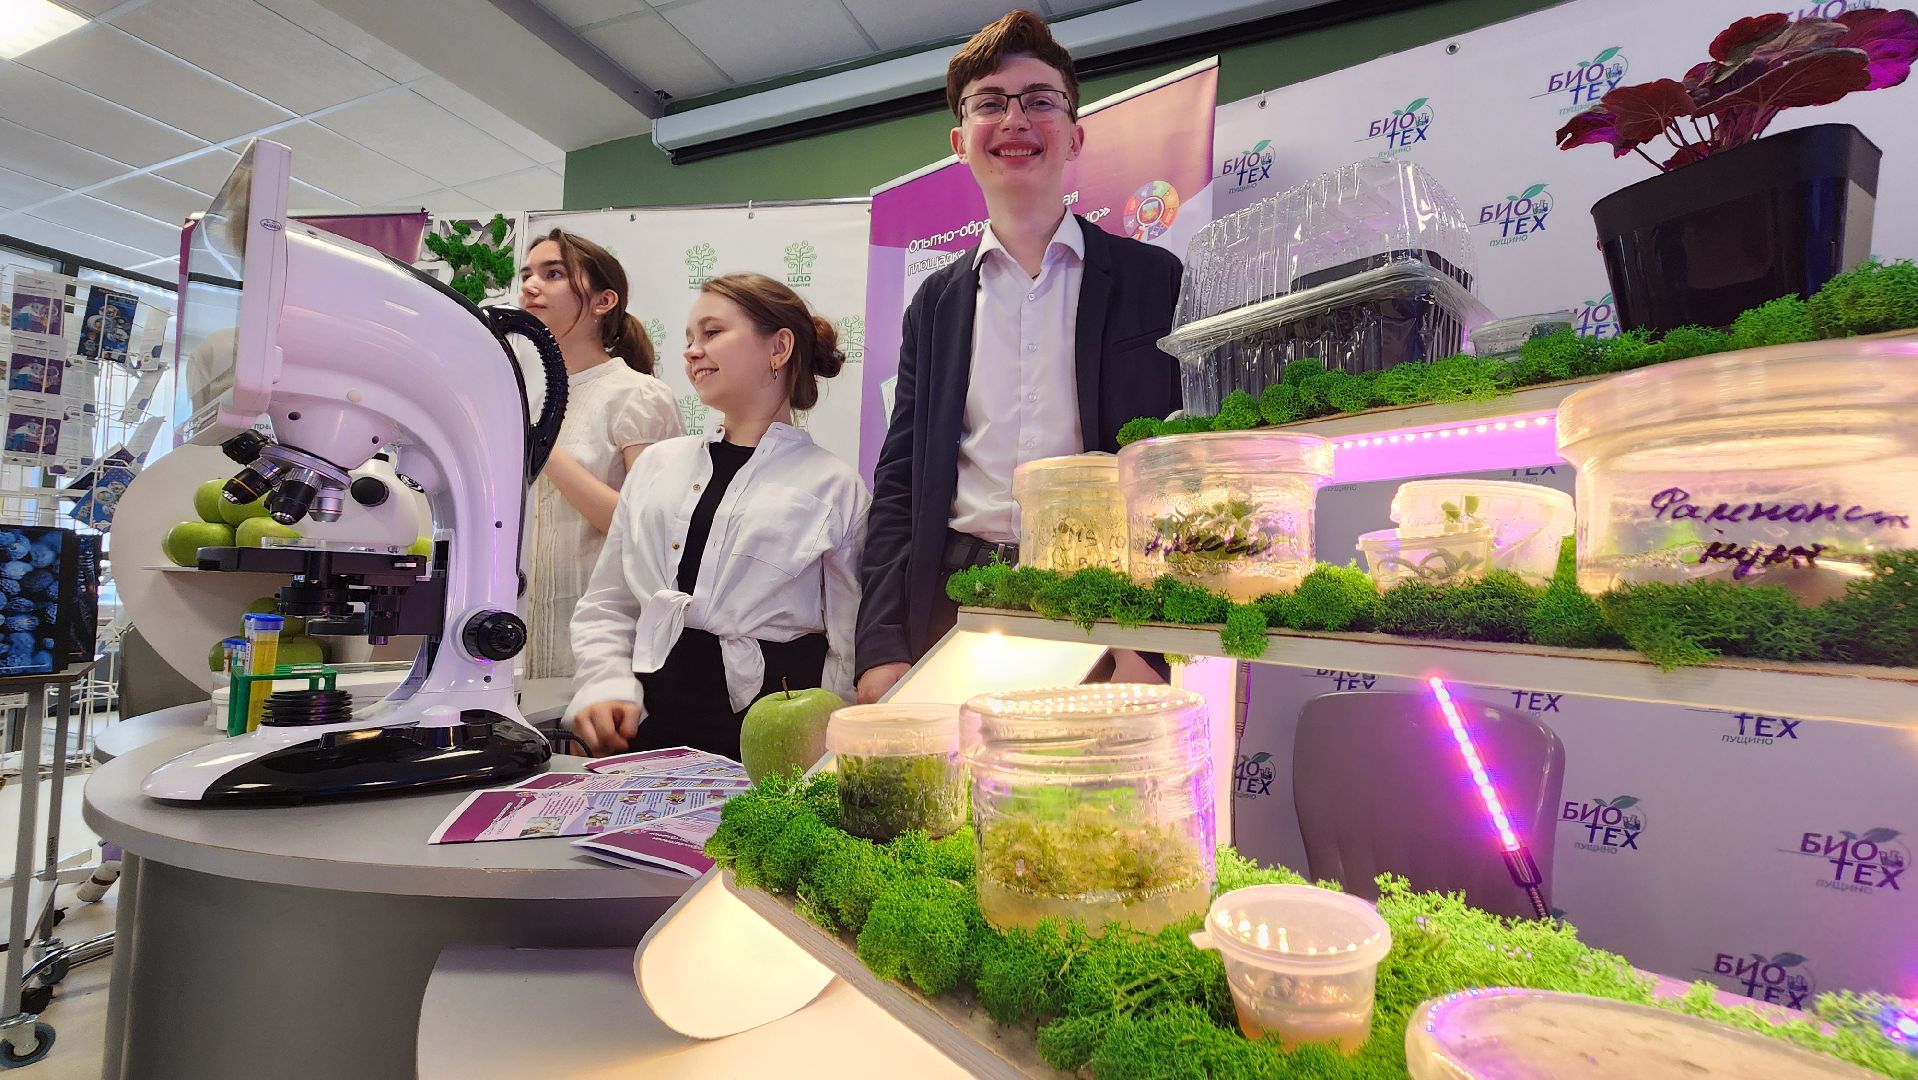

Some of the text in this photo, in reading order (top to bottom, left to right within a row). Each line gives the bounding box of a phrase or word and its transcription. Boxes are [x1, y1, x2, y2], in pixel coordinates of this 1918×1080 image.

[1547, 62, 1604, 93] БИО
[1569, 77, 1622, 105] ТЕХ
[1369, 111, 1415, 138] БИО
[1386, 125, 1430, 149] ТЕХ
[1222, 152, 1260, 175] БИО
[1236, 164, 1272, 186] ТЕХ
[1063, 190, 1079, 205] ая
[1479, 199, 1532, 224] БИО
[1499, 213, 1548, 238] ТЕХ
[1489, 235, 1528, 247] ПУЩИНО
[1574, 304, 1611, 325] ИО
[1511, 690, 1563, 712] ТЕХ
[1733, 712, 1801, 739] ТЕХ
[1721, 735, 1774, 745] ПУЩИНО
[1236, 761, 1260, 777] ИО
[1235, 776, 1272, 796] ТЕХ
[1562, 801, 1622, 826] БИО
[1584, 824, 1641, 850] ТЕХ
[1800, 832, 1878, 861] БИО
[1829, 859, 1904, 890] ТЕХ
[1714, 953, 1786, 985] БИО
[1741, 980, 1809, 1010] ТЕХ
